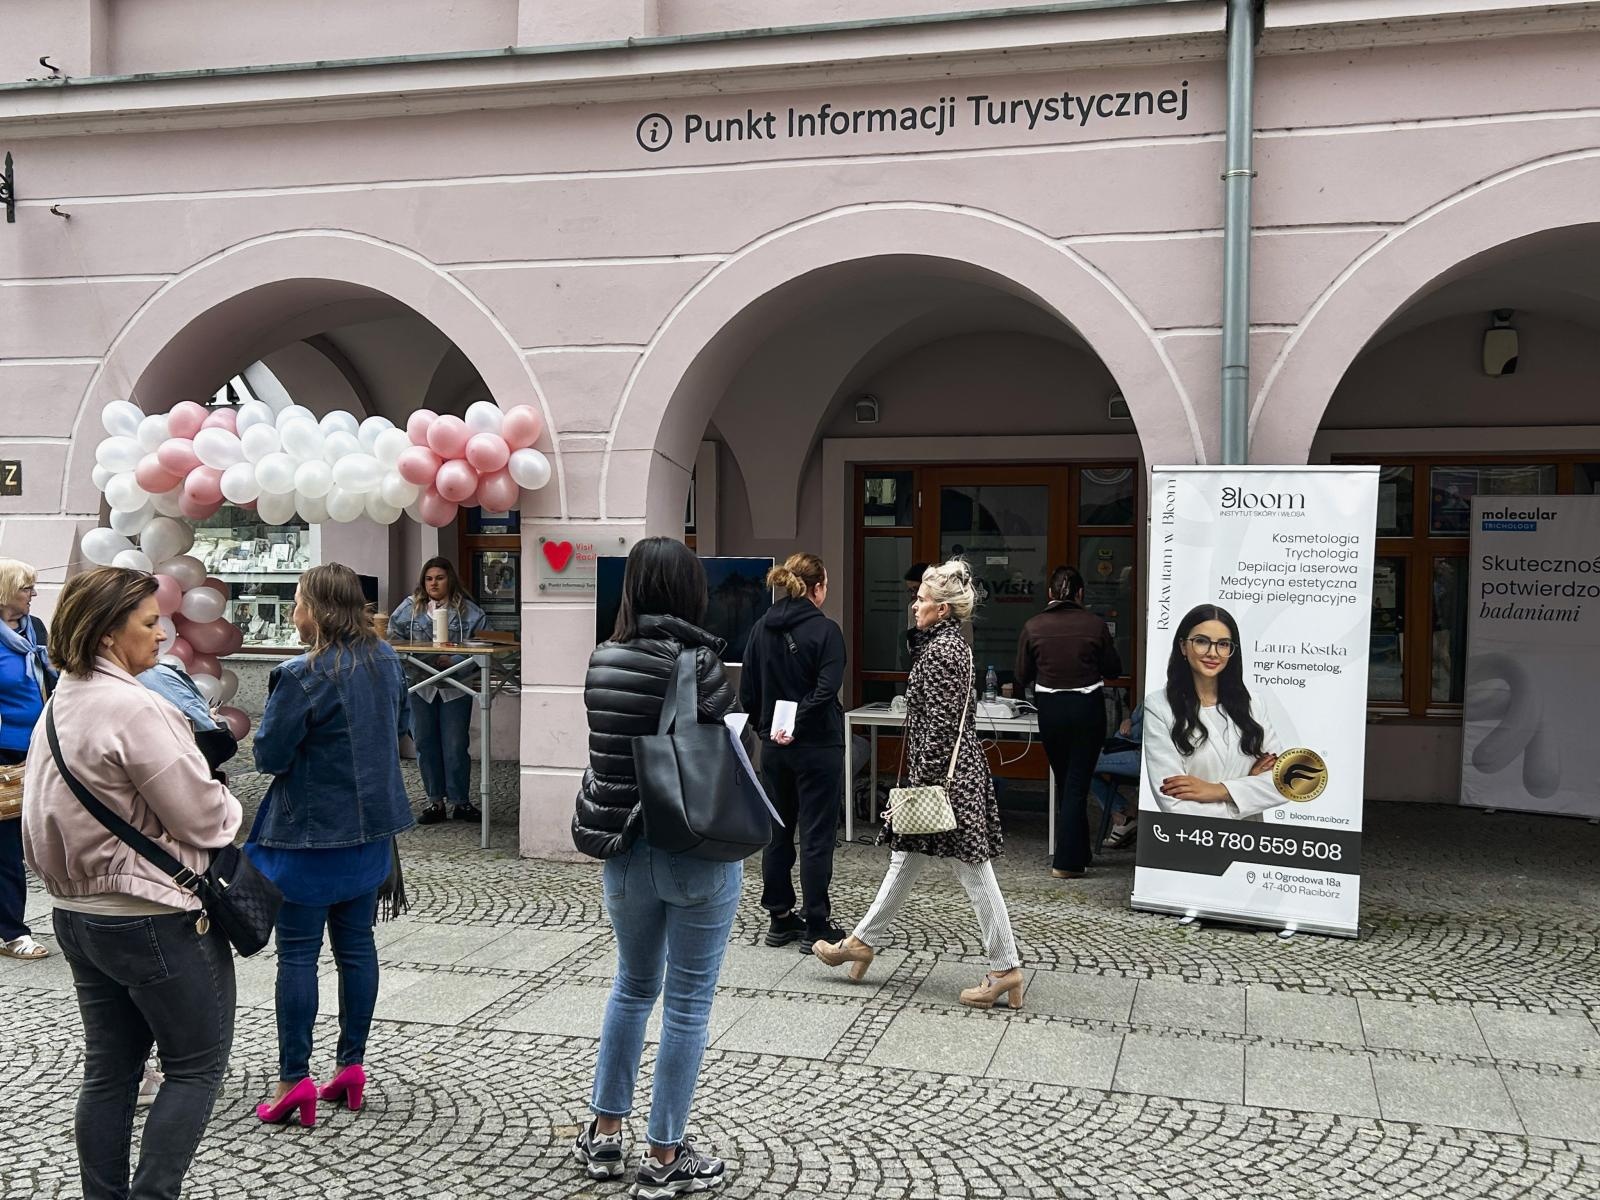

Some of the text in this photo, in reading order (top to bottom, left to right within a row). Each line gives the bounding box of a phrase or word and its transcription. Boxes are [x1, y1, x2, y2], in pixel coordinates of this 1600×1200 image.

[685, 80, 1188, 143] Punkt Informacji Turystycznej
[1221, 487, 1305, 509] Bloom
[1482, 507, 1558, 520] molecular
[1484, 522, 1535, 530] TRICHOLOGY
[1272, 533, 1360, 547] Kosmetologia
[576, 553, 597, 561] Raci
[1157, 479, 1177, 630] Rozkwitam w Bloom
[1285, 547, 1359, 562] Trychologia
[1238, 561, 1358, 576] Depilacja laserowa
[1482, 555, 1600, 574] Skutecznoś
[992, 579, 1036, 595] Visit
[1220, 575, 1357, 591] Medycyna estetyczna
[1481, 580, 1600, 599] potwierdzo
[1218, 589, 1357, 606] Zabiegi pielęgnacyjne
[1480, 602, 1582, 622] badaniami
[1255, 640, 1347, 656] Laura Kostka
[1254, 660, 1342, 675] mgr Kosmetolog,
[1254, 673, 1306, 688] Trycholog
[1290, 811, 1350, 825] bloom.raciborz
[1176, 829, 1342, 861] +48 780 559 508
[1262, 872, 1341, 887] ul. Ogrodowa 18a
[1262, 882, 1341, 899] 47-400 Racibórz
